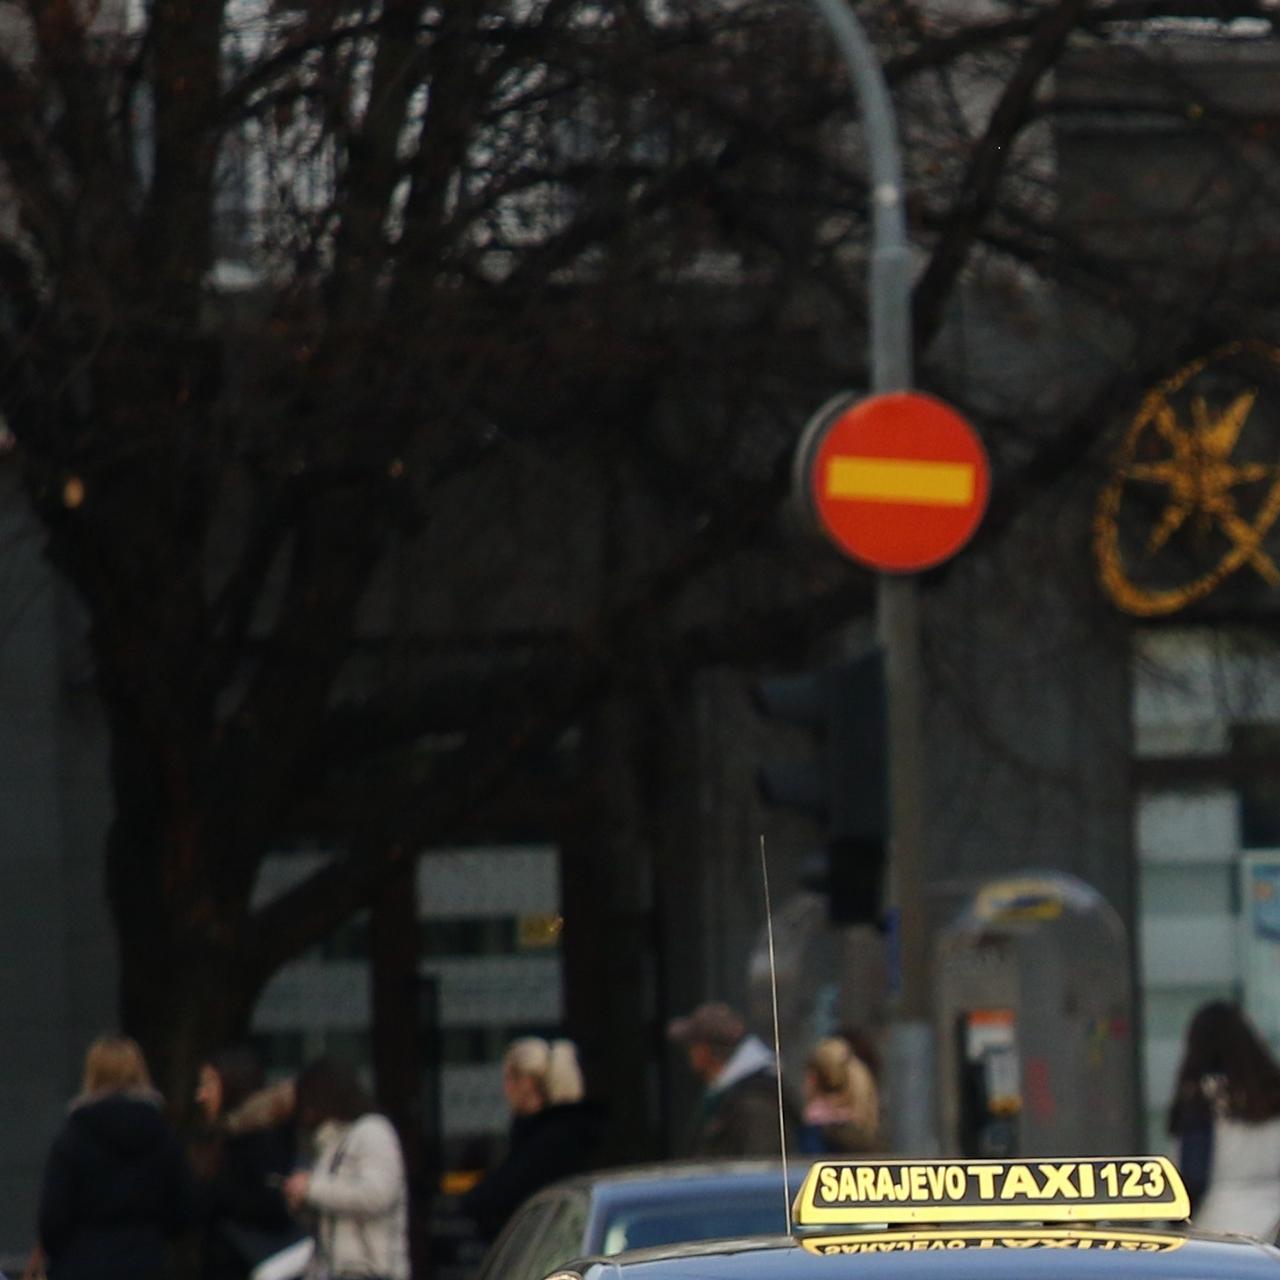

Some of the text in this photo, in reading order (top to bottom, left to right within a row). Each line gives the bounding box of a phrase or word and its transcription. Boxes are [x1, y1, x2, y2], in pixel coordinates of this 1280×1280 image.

[820, 1163, 1165, 1202] SARAJEVO TAXI 123
